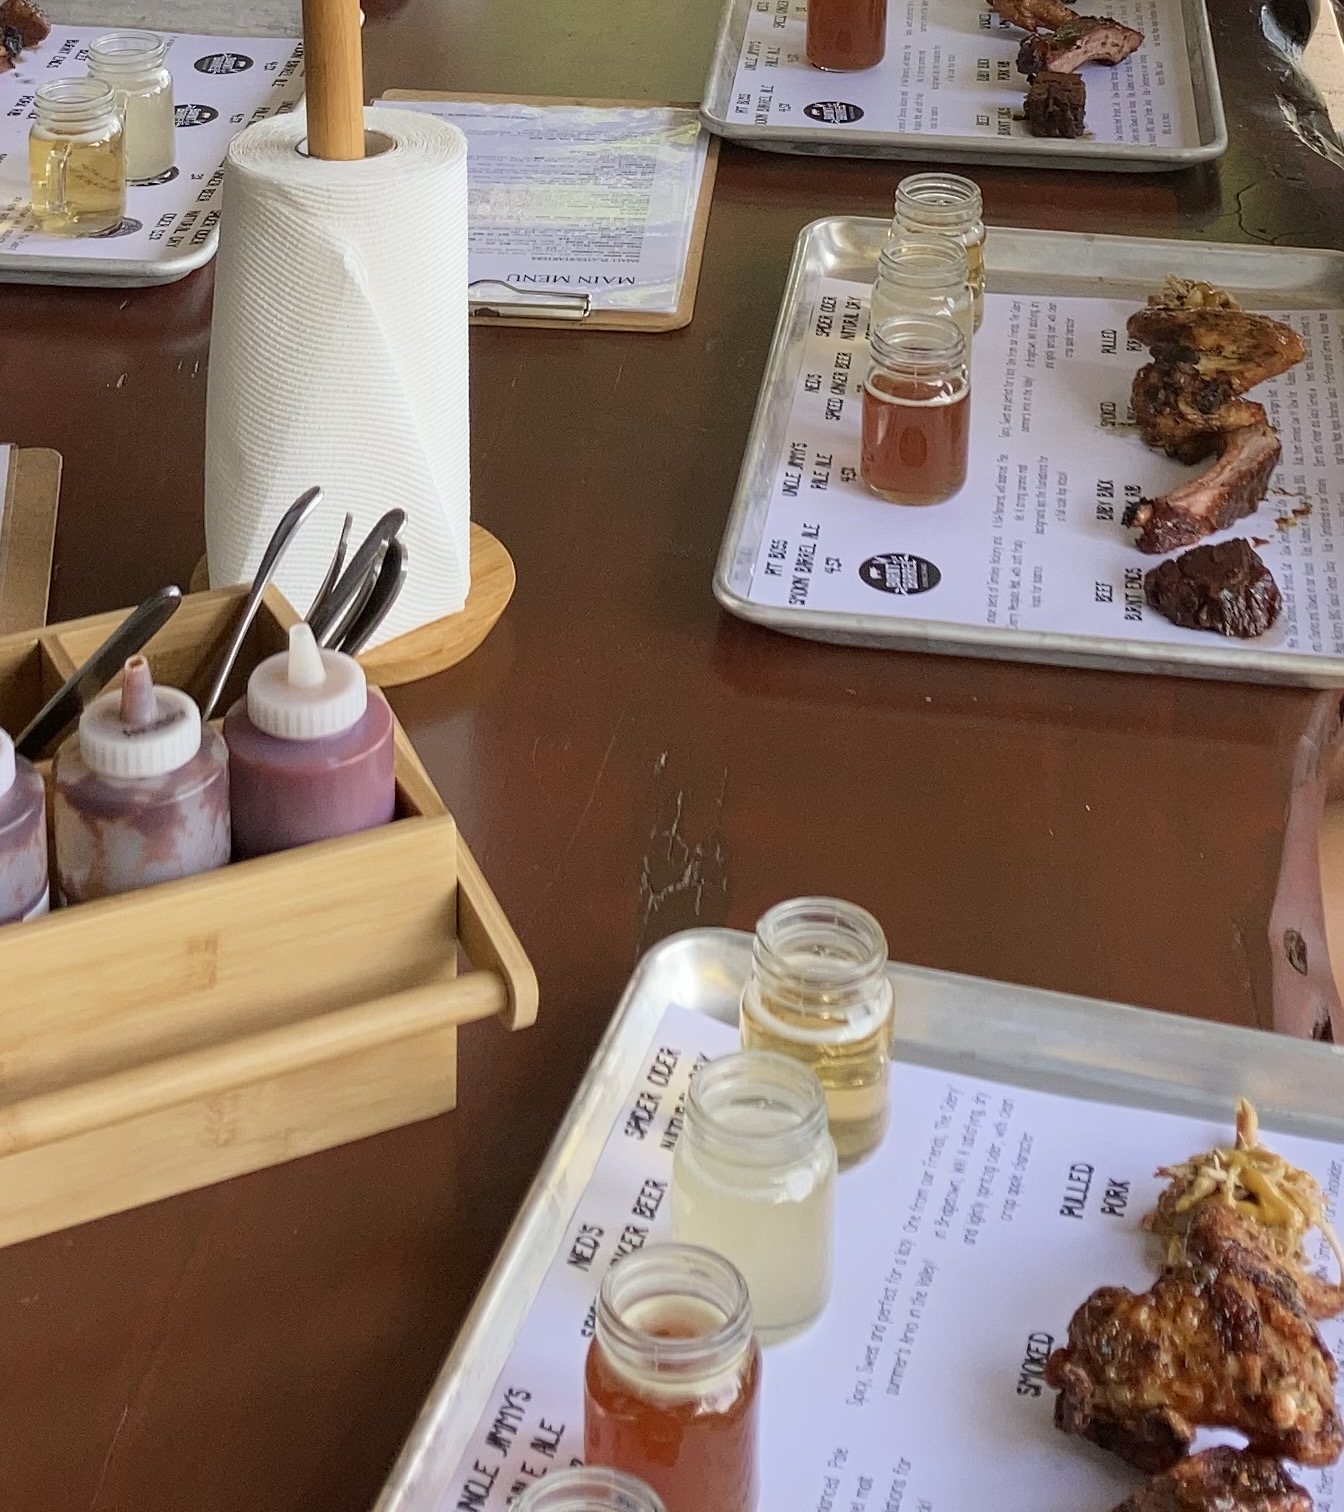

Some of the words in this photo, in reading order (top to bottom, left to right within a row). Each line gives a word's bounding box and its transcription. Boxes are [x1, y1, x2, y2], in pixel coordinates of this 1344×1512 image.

[505, 273, 571, 284] MENU
[577, 275, 636, 285] MAIN
[1095, 581, 1113, 603] BEEF
[1124, 592, 1143, 621] BURNT
[631, 1178, 667, 1221] BEER
[1059, 1162, 1094, 1220] PULLED
[1101, 1178, 1130, 1217] PORK
[1016, 1332, 1054, 1397] SMOKED
[456, 1458, 500, 1512] NCLE
[484, 1387, 532, 1458] JIMMY'S
[529, 1417, 565, 1458] ALE
